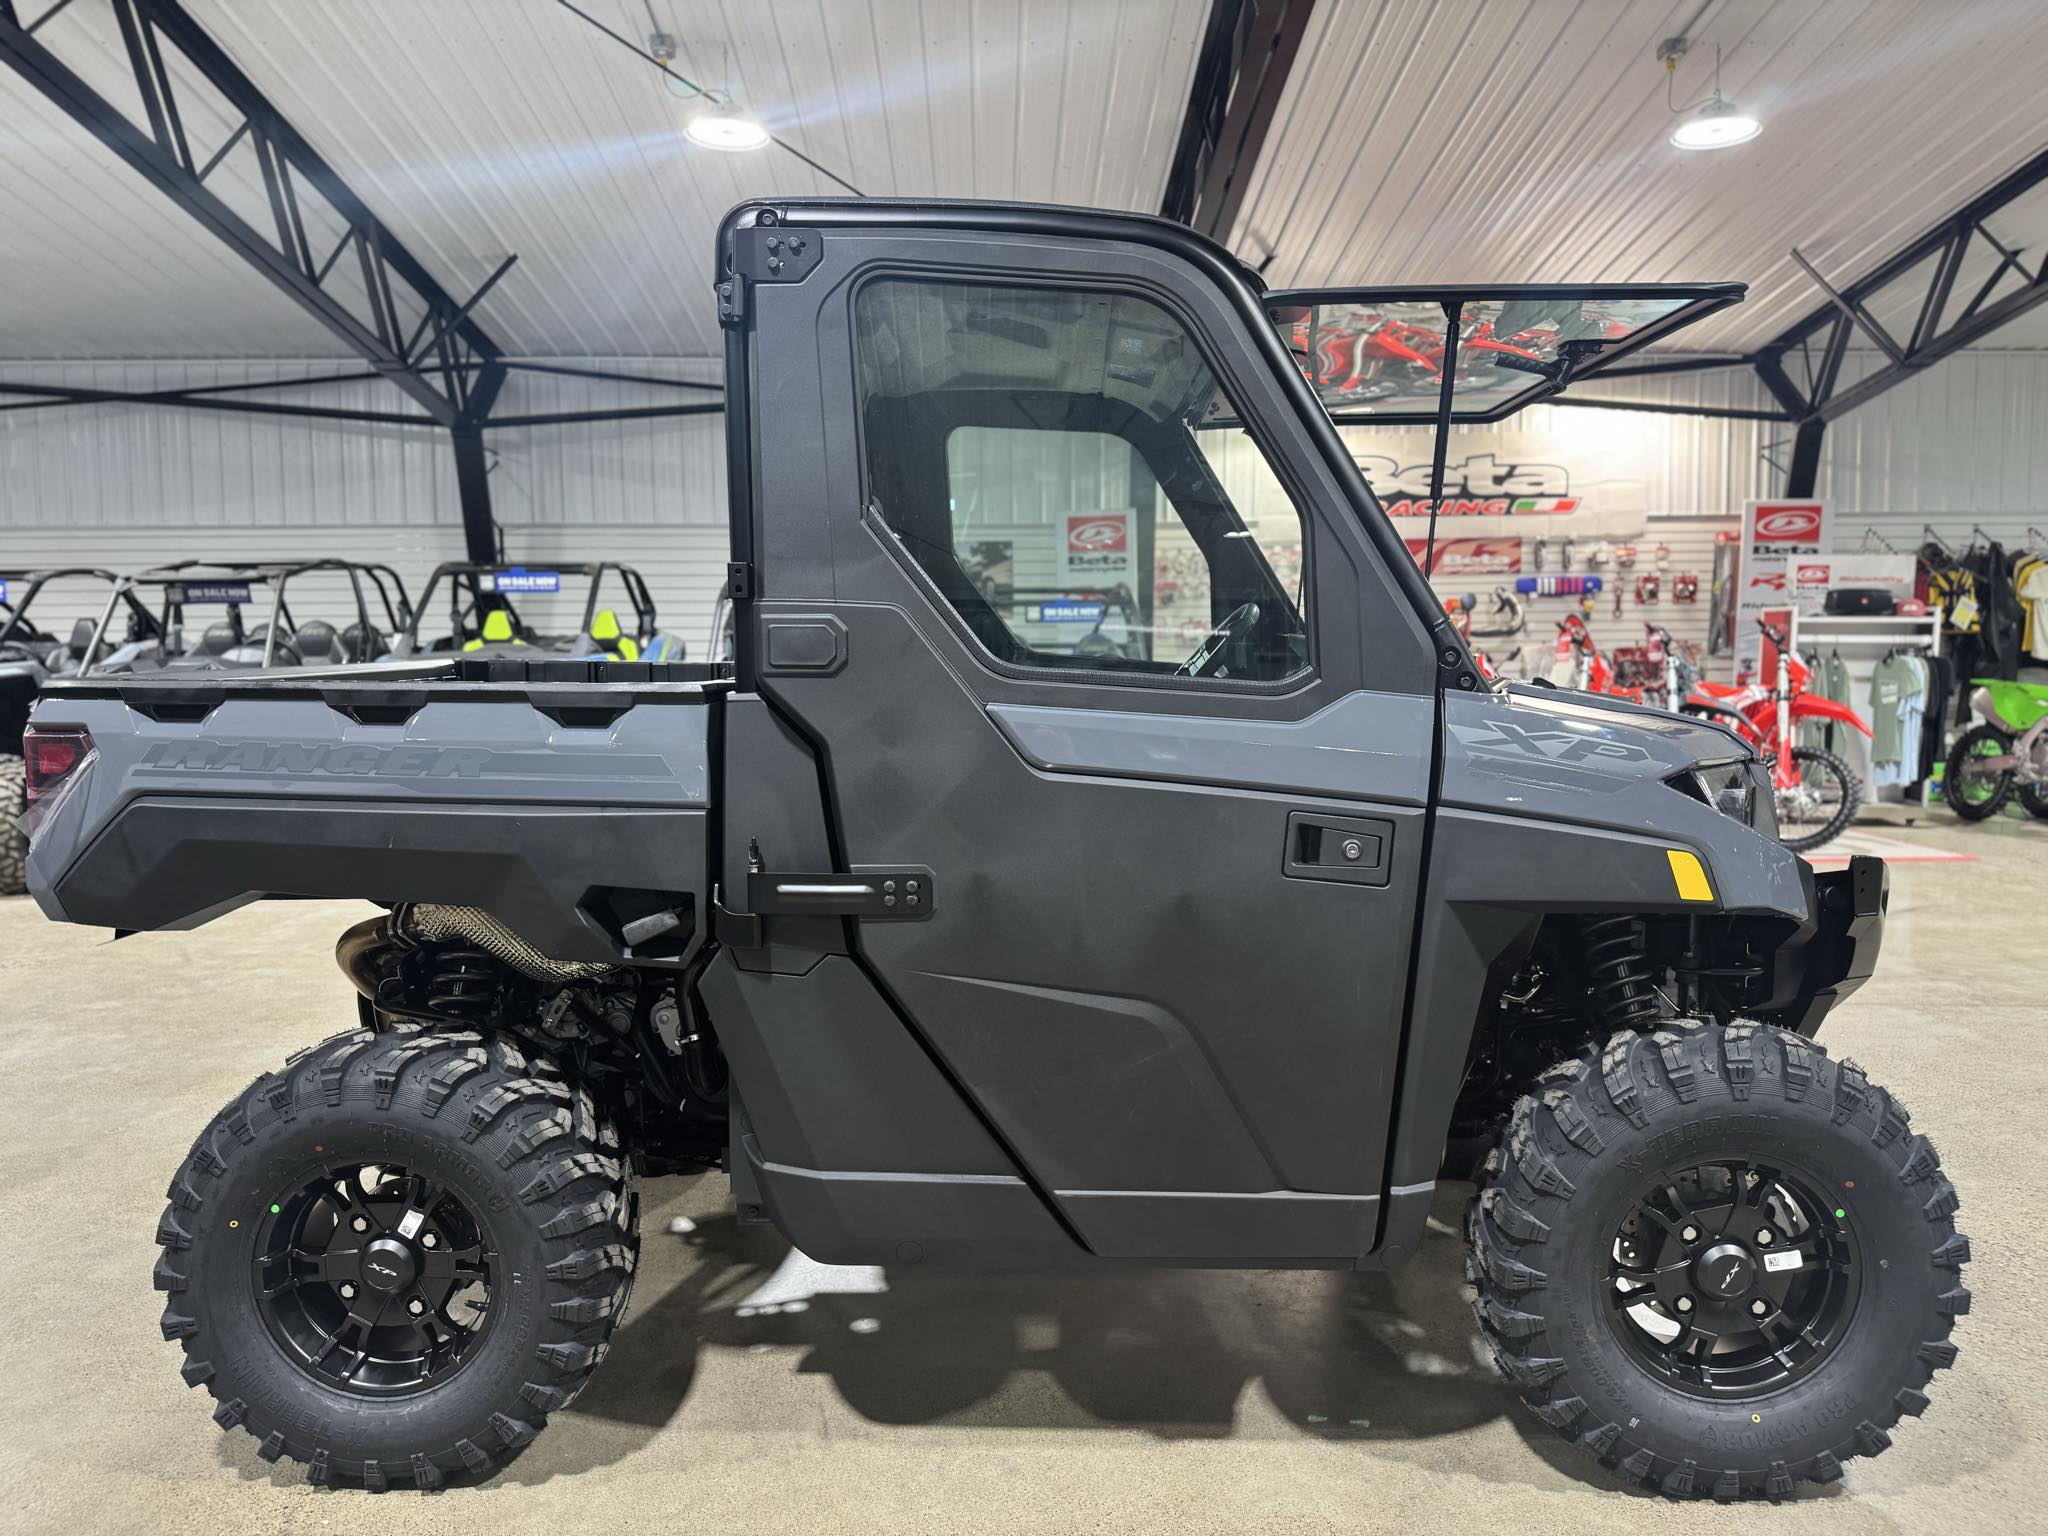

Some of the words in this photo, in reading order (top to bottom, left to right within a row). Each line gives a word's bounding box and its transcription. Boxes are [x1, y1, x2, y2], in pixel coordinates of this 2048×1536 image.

[1752, 545, 1819, 555] Beta
[1068, 555, 1127, 566] Beta
[498, 577, 511, 586] ON
[512, 576, 535, 586] SALE
[536, 576, 557, 586] NOW
[188, 588, 202, 597] ON
[203, 588, 226, 597] SALE
[227, 588, 248, 597] NOW
[1043, 607, 1056, 616] ON
[1057, 607, 1079, 616] SALE
[1080, 607, 1100, 616] NOW
[1461, 719, 1653, 762] XP
[152, 740, 493, 778] RANGER
[367, 1262, 398, 1277] XP
[1720, 1261, 1741, 1289] XP
